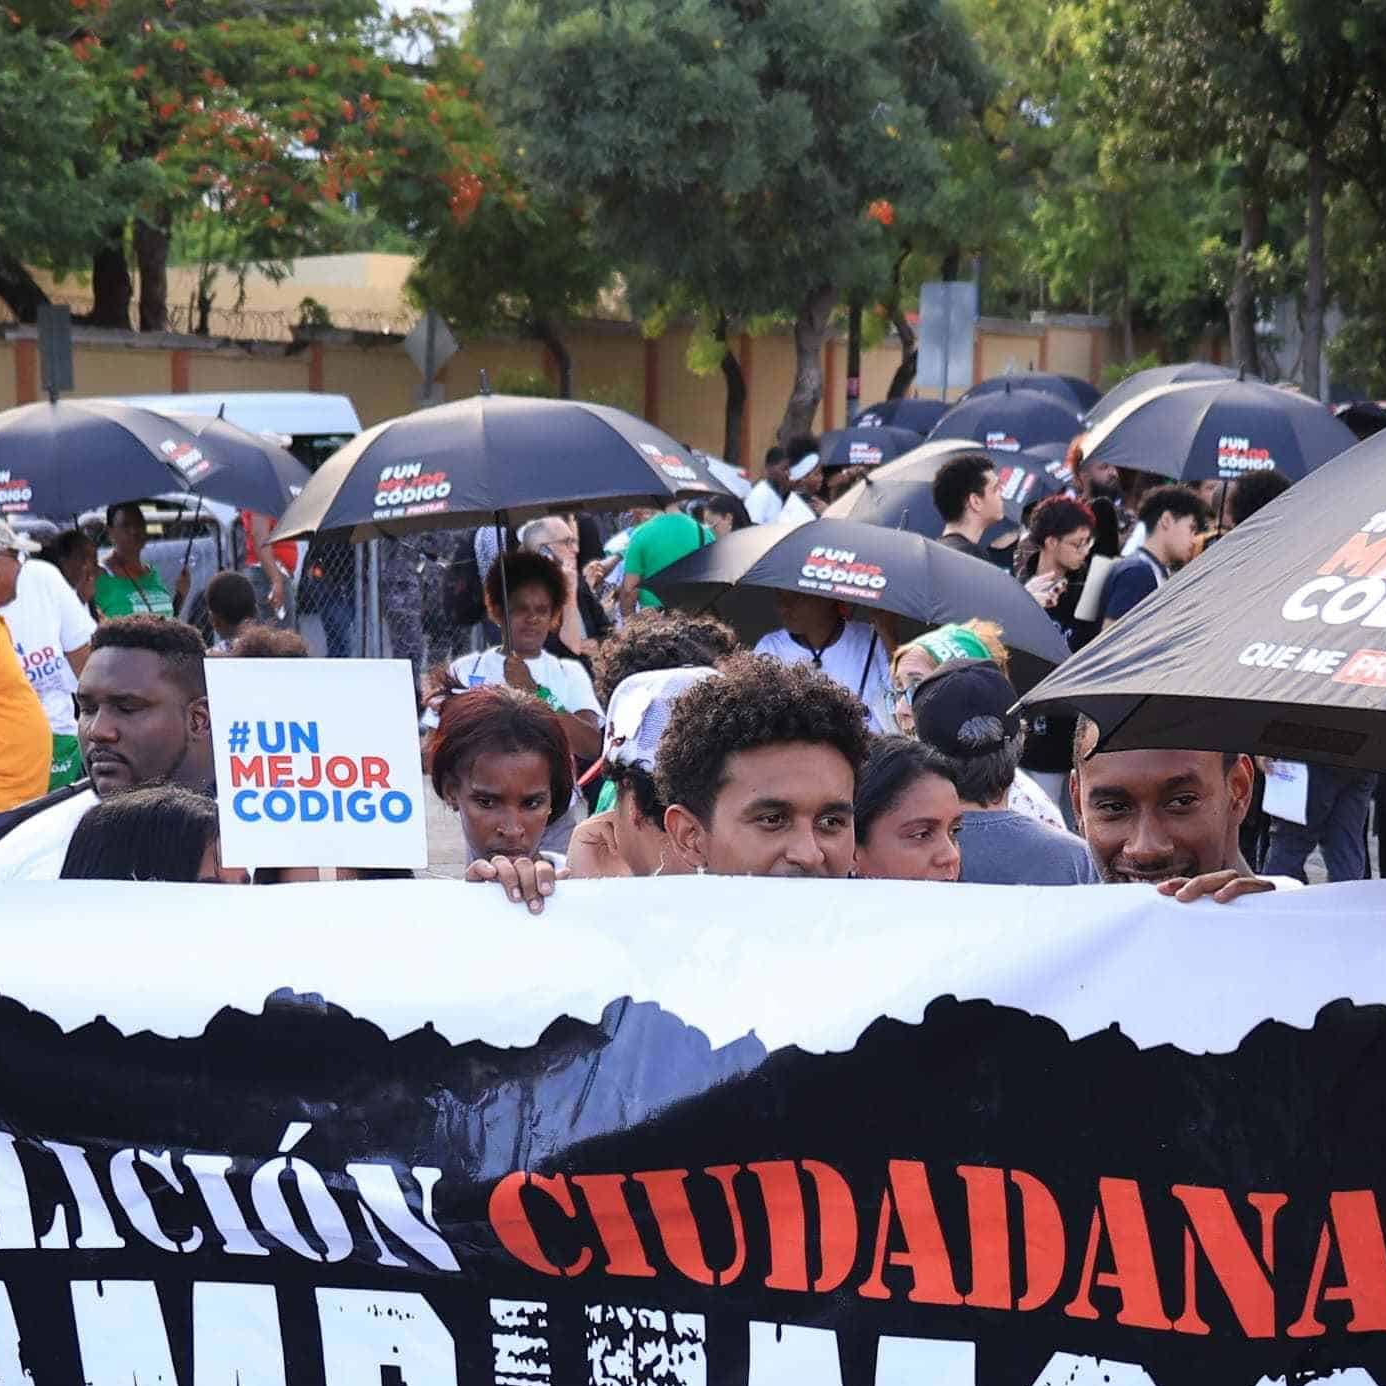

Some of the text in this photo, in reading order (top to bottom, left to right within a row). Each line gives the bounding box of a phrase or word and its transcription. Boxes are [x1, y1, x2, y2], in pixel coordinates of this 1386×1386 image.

[380, 462, 422, 482] #UN
[810, 547, 856, 564] #UN
[1237, 641, 1301, 670] QUE
[1297, 647, 1348, 675] ME
[228, 721, 320, 753] #UN
[229, 755, 391, 788] MEJOR
[233, 779, 413, 823] CÓDIGO
